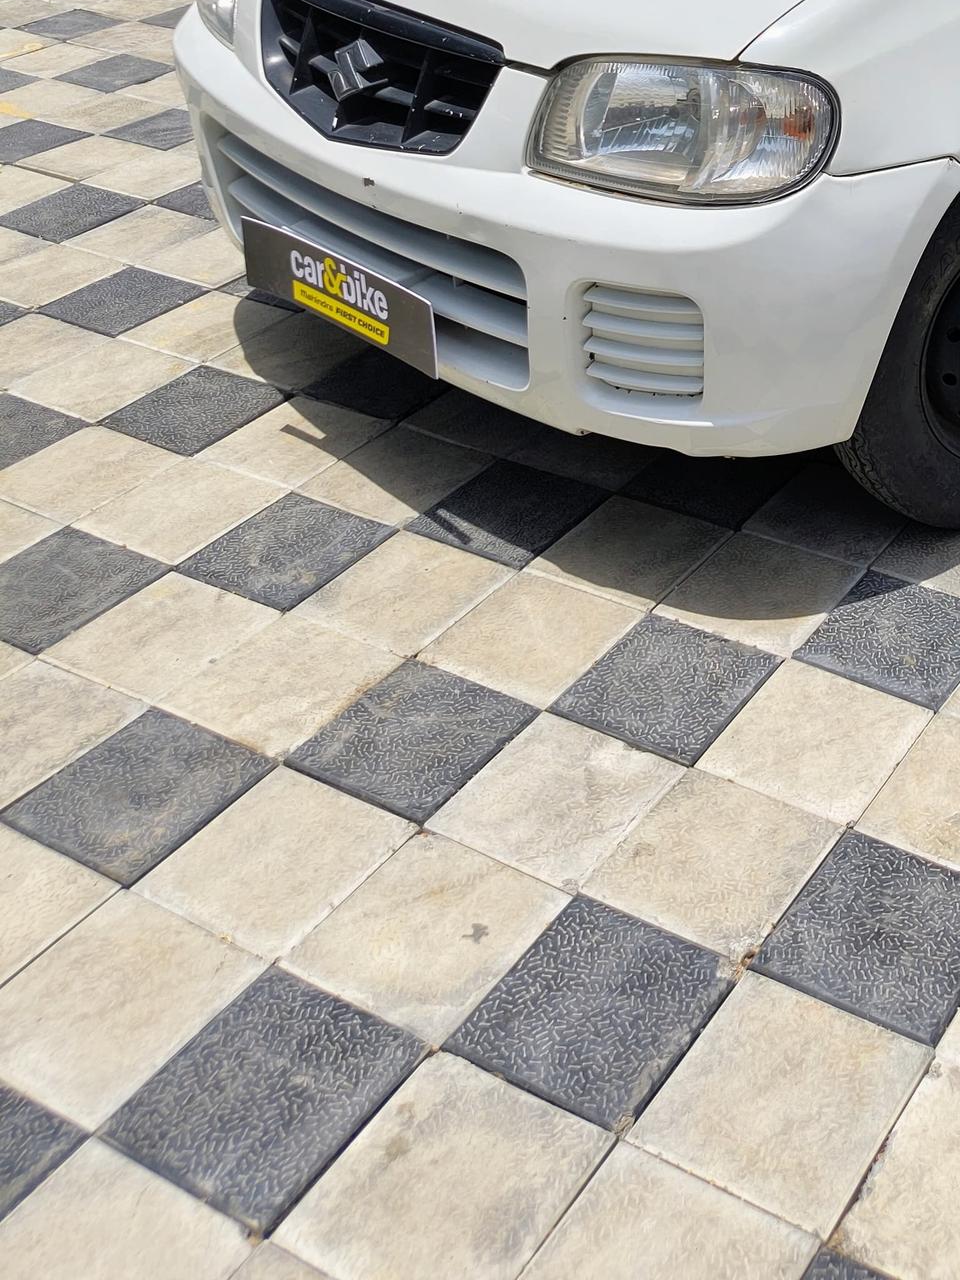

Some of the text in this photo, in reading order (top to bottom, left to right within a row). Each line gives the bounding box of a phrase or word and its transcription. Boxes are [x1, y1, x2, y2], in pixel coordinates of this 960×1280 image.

[290, 249, 389, 320] car&bike
[335, 306, 357, 323] FIRST
[357, 319, 385, 338] CHOICE
